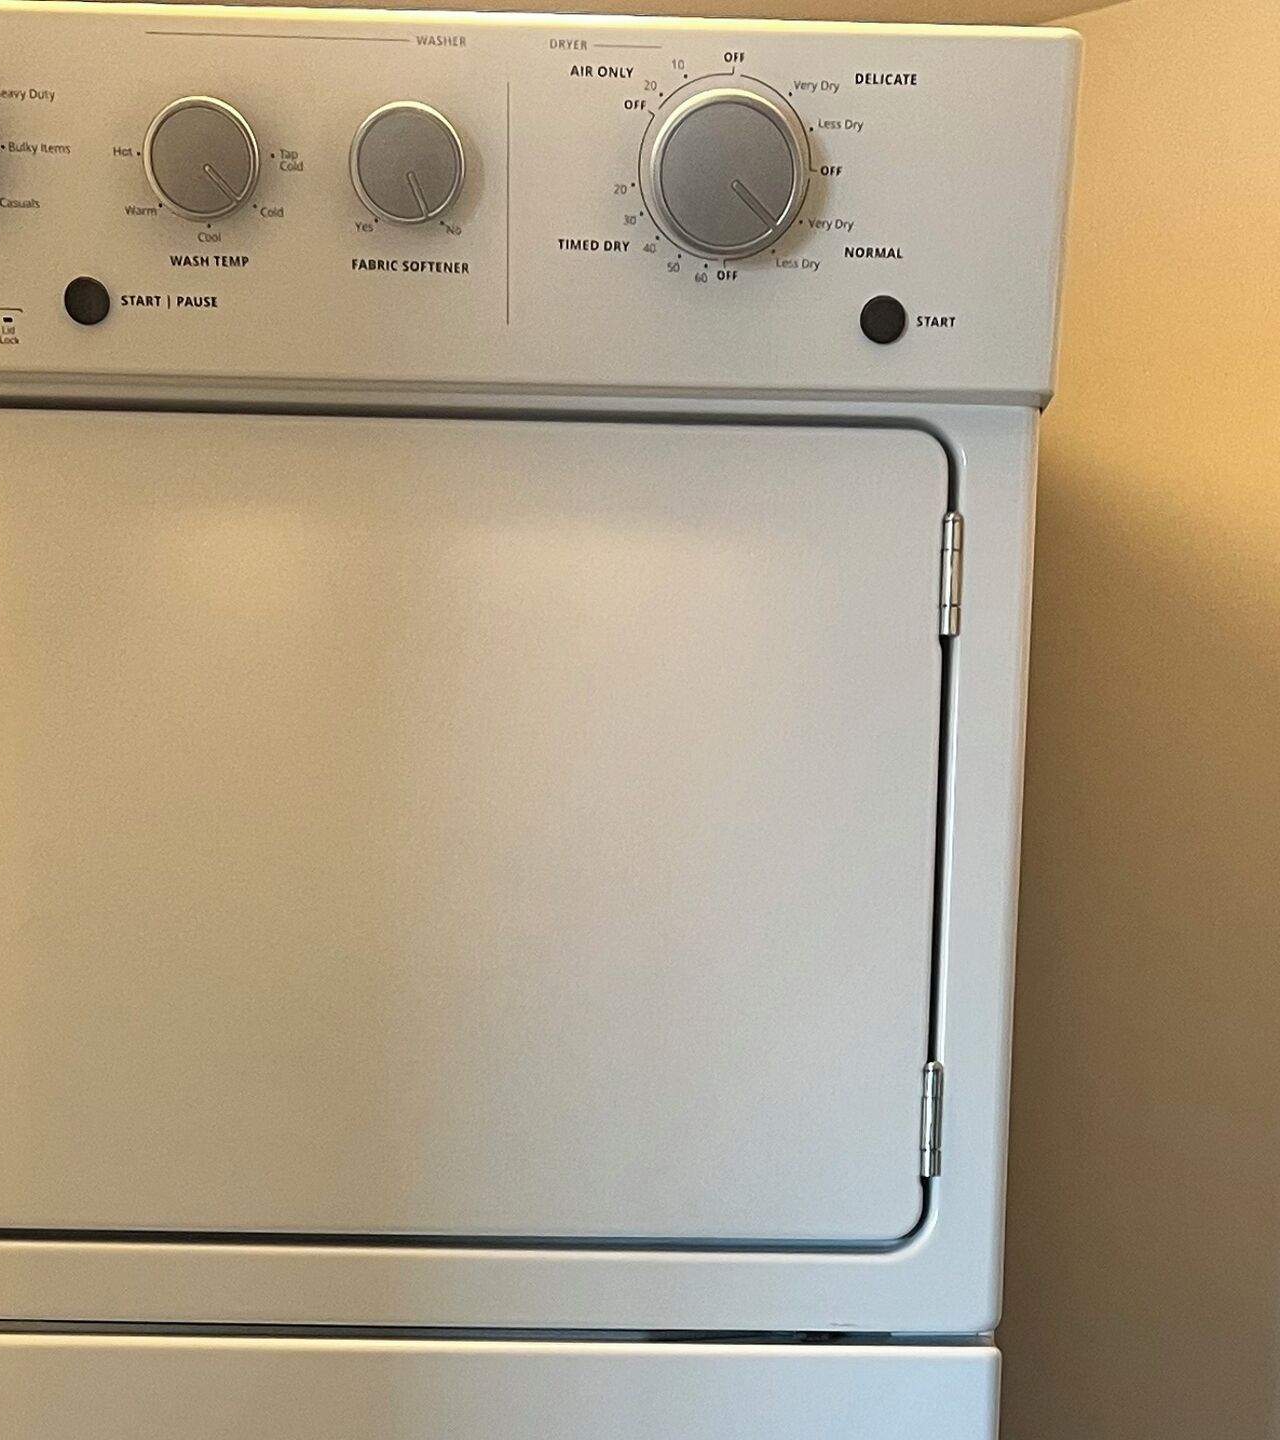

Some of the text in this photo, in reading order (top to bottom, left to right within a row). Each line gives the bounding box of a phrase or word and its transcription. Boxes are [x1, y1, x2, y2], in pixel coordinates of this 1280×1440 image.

[417, 36, 467, 48] WASHER
[549, 39, 588, 51] DRYER
[723, 52, 745, 63] OFF
[671, 59, 685, 70] 10
[570, 66, 634, 78] AIR ONLY
[644, 80, 658, 91] 20
[854, 73, 918, 86] DELICATE
[793, 79, 840, 94] Very Dry
[29, 89, 56, 102] Duty
[623, 99, 648, 111] OFF
[818, 118, 864, 133] Less Dry
[8, 142, 71, 155] Bulky Items
[113, 147, 133, 157] Hot
[279, 149, 299, 160] Tap
[279, 161, 304, 172] Cold
[820, 165, 843, 177] OFF
[613, 184, 628, 195] 20
[125, 206, 158, 217] Warm
[260, 207, 284, 218] Cold
[623, 215, 637, 226] 30
[808, 219, 855, 233] Very Dry
[354, 221, 374, 233] Yes
[446, 224, 463, 236] No
[198, 232, 222, 243] Cool
[558, 239, 630, 252] TIMED DRY
[642, 243, 657, 253] 40
[844, 247, 903, 260] NORMAL
[169, 255, 249, 268] WASH TEMP
[351, 259, 470, 275] FABRIC SOFTENER
[776, 258, 821, 272] Less Dry
[666, 262, 681, 274] 50
[694, 272, 708, 284] 60
[716, 270, 738, 282] OFF
[121, 295, 218, 308] START PAUSE
[916, 315, 956, 328] START
[2, 326, 16, 335] Lid
[0, 335, 20, 345] Lock
